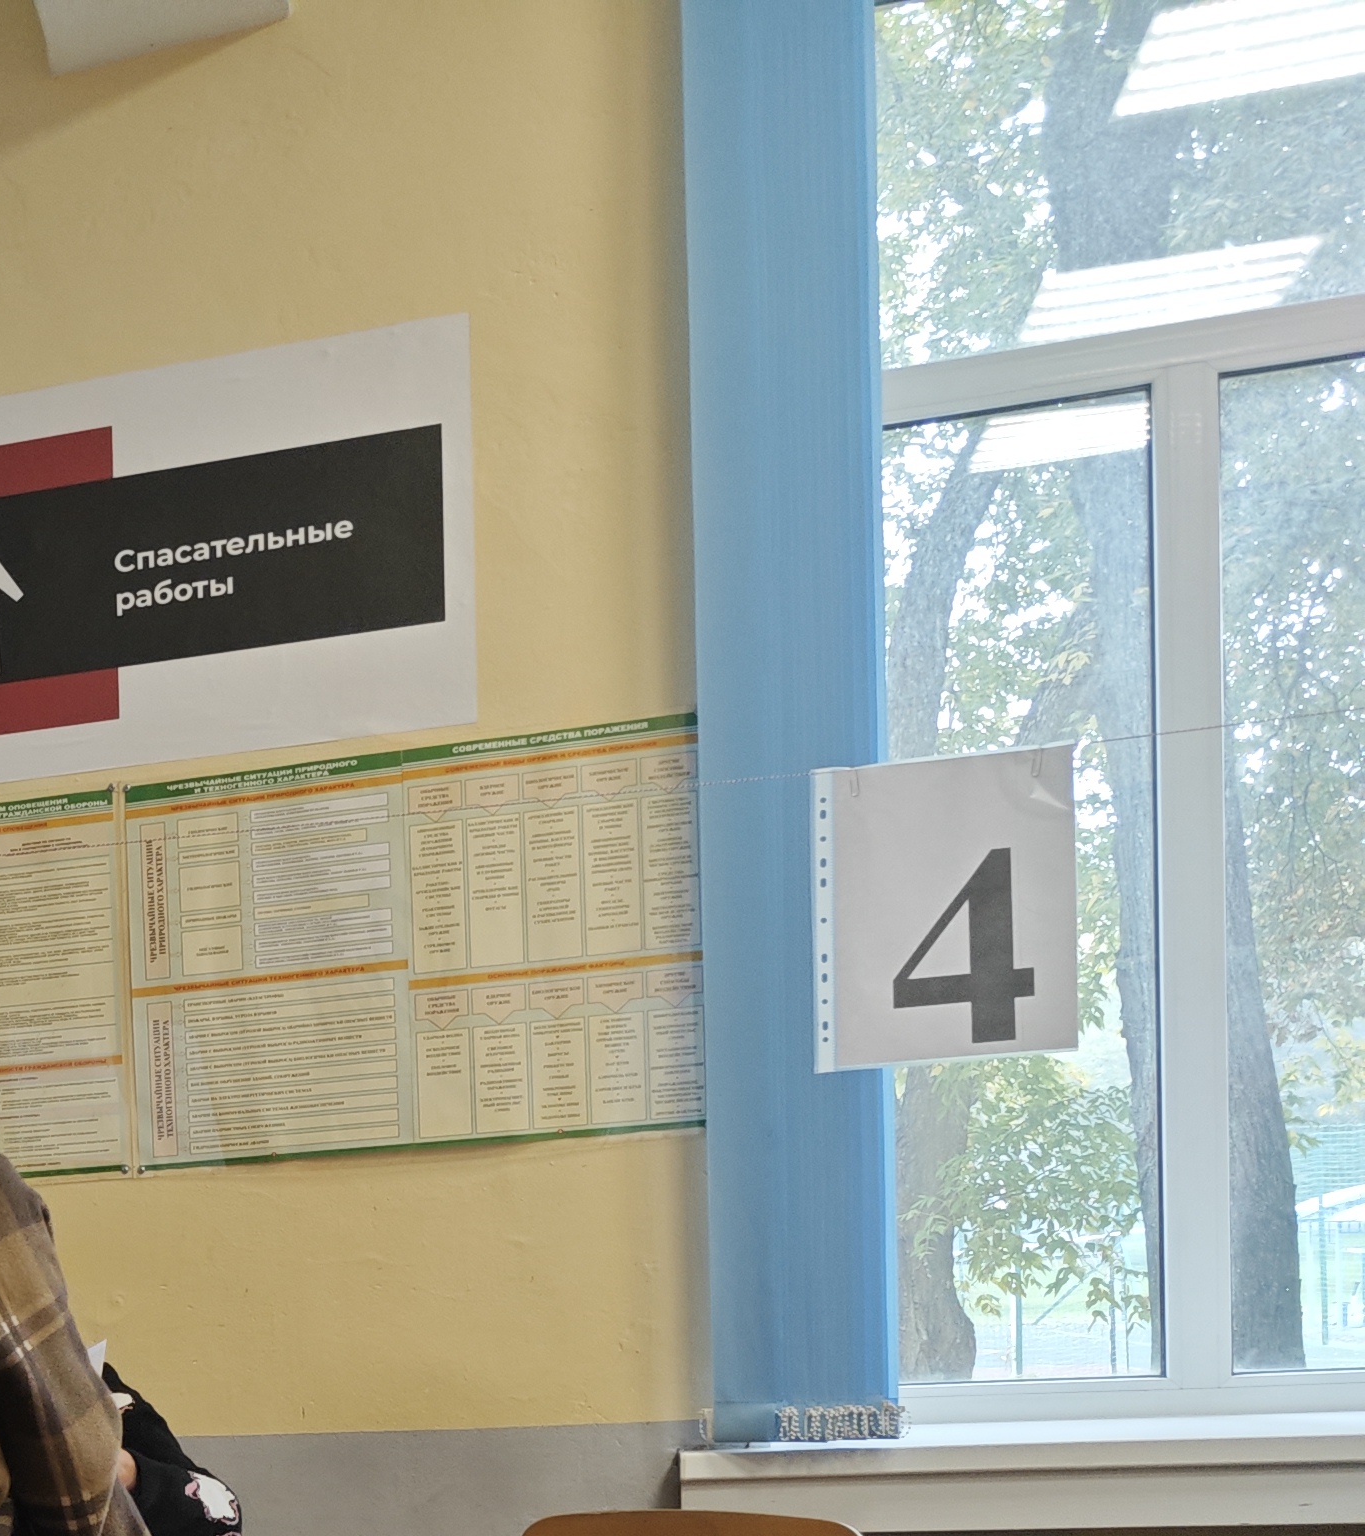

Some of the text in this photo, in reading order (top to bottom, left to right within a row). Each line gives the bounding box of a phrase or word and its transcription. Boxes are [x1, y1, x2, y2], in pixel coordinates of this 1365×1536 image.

[113, 519, 355, 573] Спасательные
[115, 576, 235, 617] работы
[452, 722, 648, 754] СОВРЕМЕННЫЕ СРЕДСТВА ПОРАЖЕНИЯ
[167, 759, 357, 791] ЧРЕЗВЫЧАЙНЫЕ СИТУАЦИИ ПРИРОДНОГО
[202, 778, 274, 792] ТЕХНОГЕННОГО
[277, 770, 329, 783] ХАРАКТЕРА
[8, 798, 68, 811] ОПОВЕЩЕНИЯ
[64, 799, 108, 811] ОБОРОНЫ
[893, 847, 1035, 1043] 4
